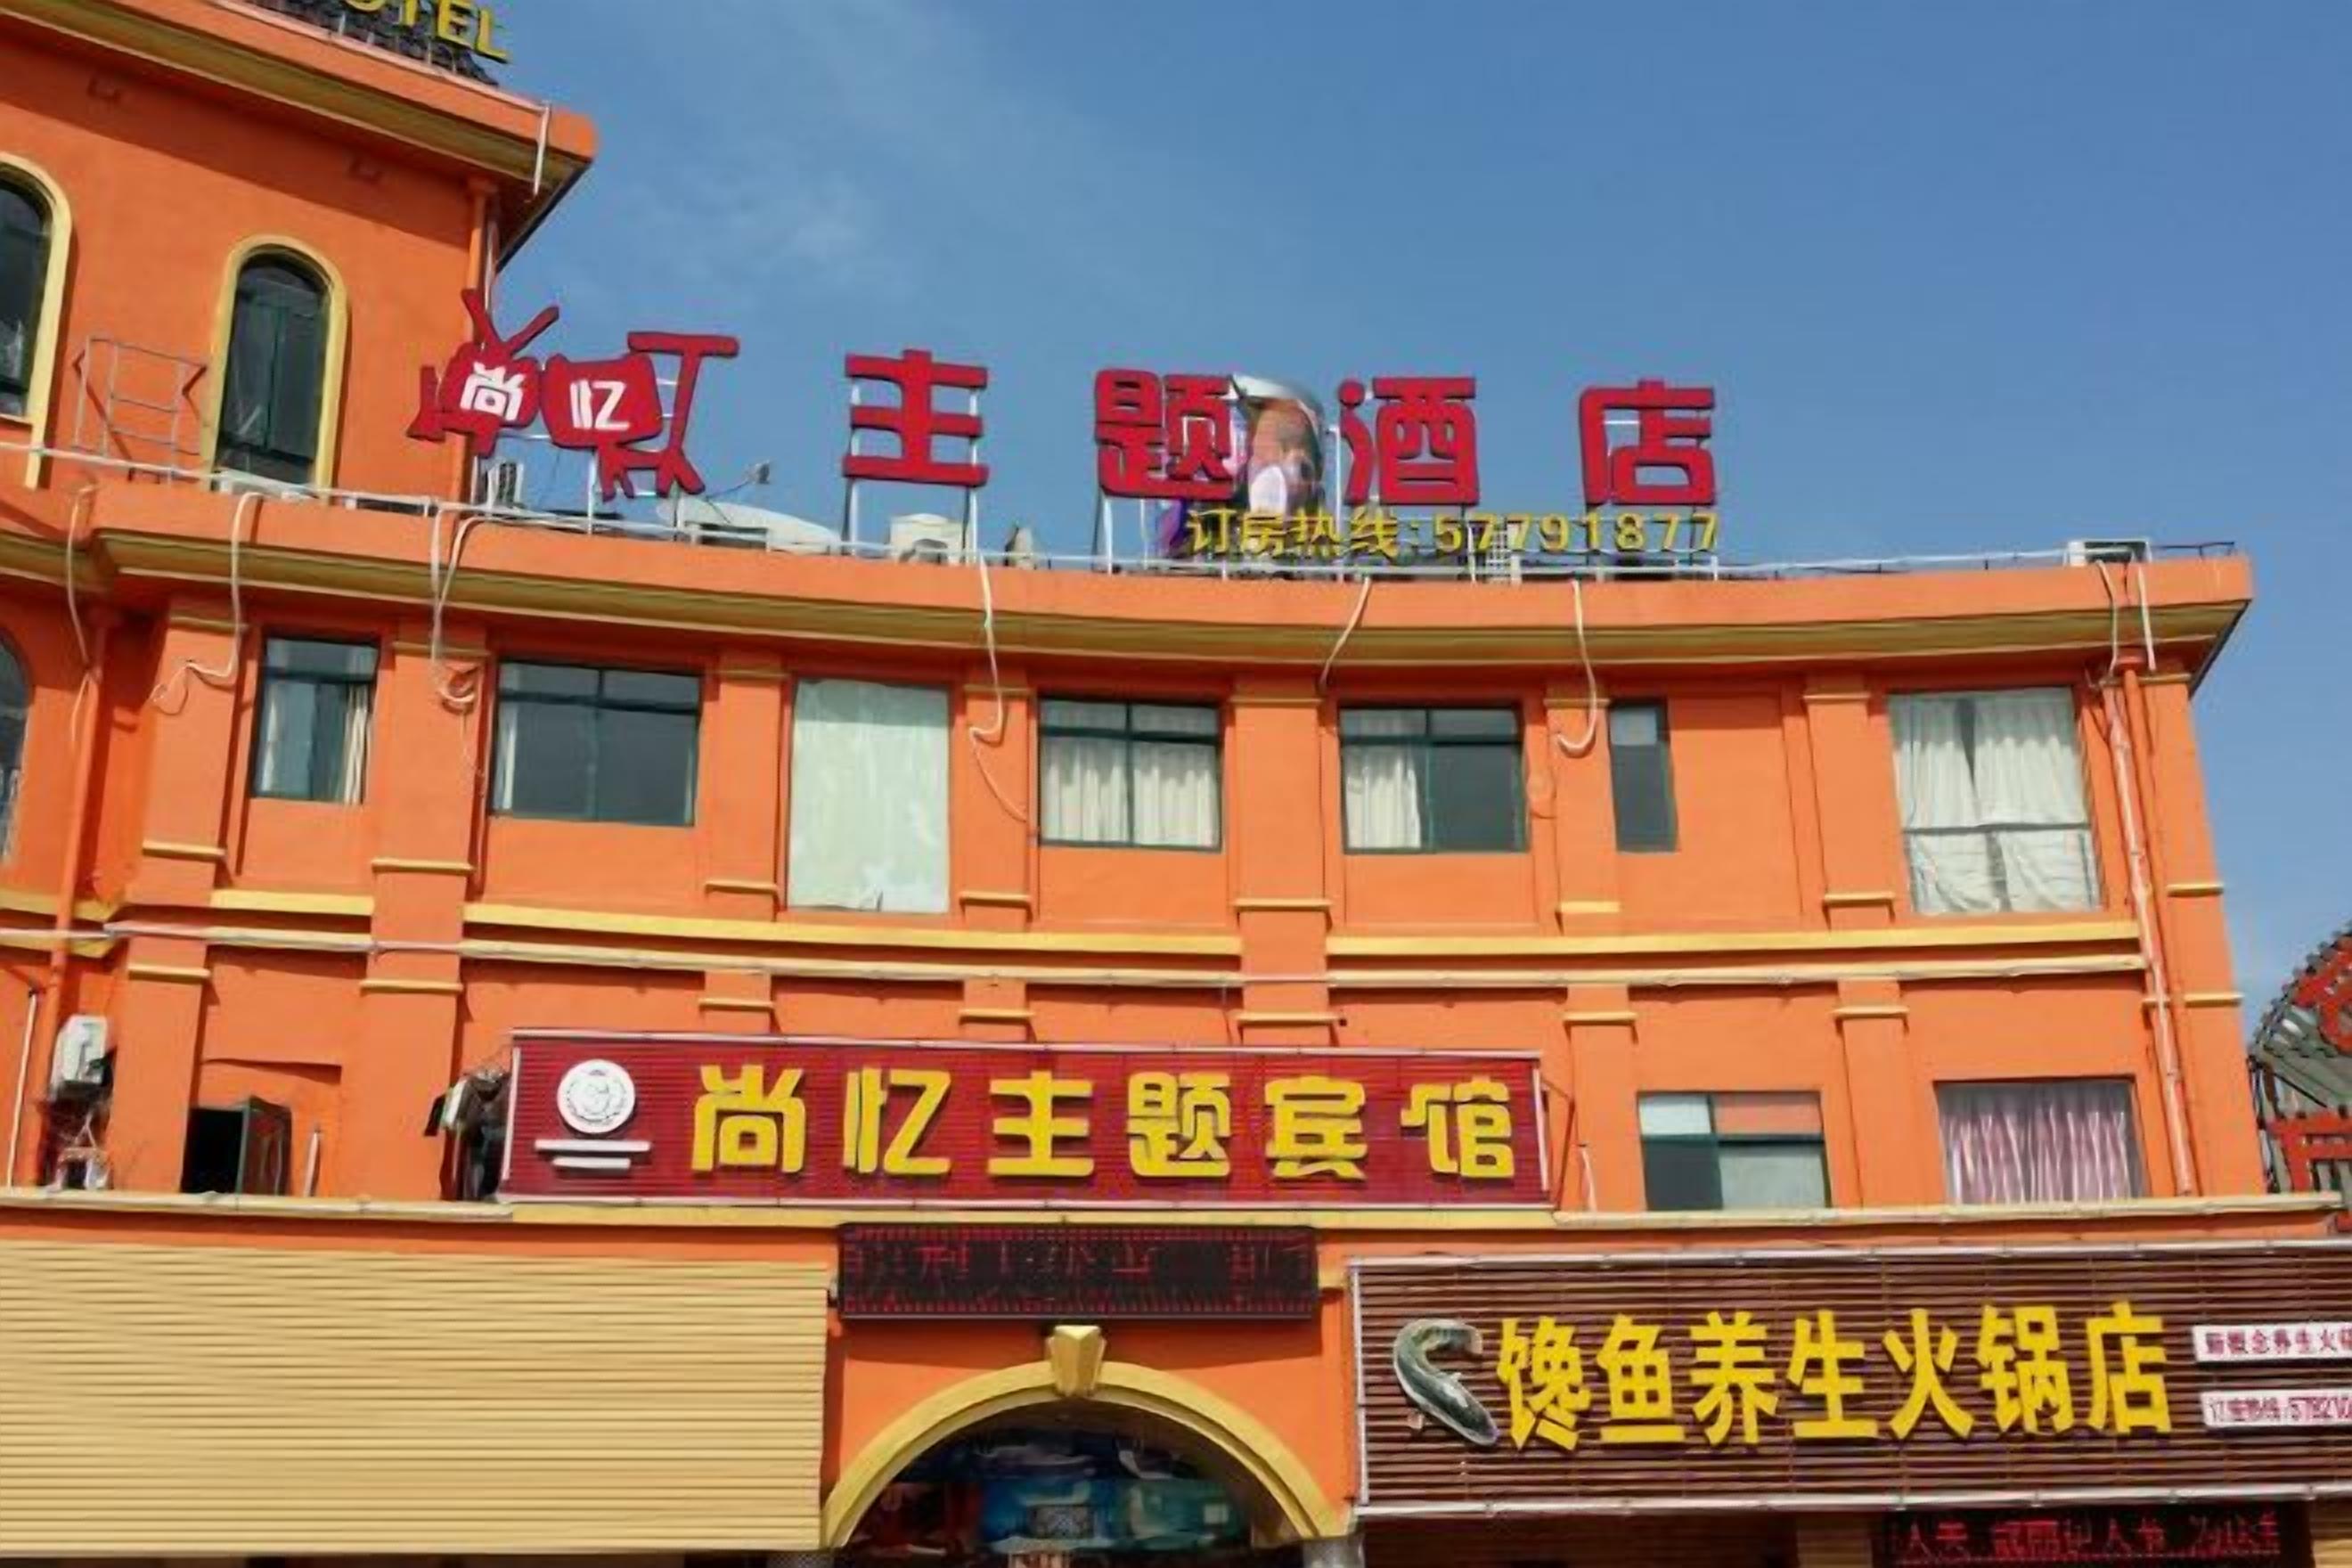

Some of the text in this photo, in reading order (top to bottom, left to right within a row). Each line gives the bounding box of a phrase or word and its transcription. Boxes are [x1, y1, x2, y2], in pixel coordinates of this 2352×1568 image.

[691, 1064, 1515, 1179] 尚忆主题宾馆
[1497, 1303, 2172, 1450] 馋鱼养生火锅店
